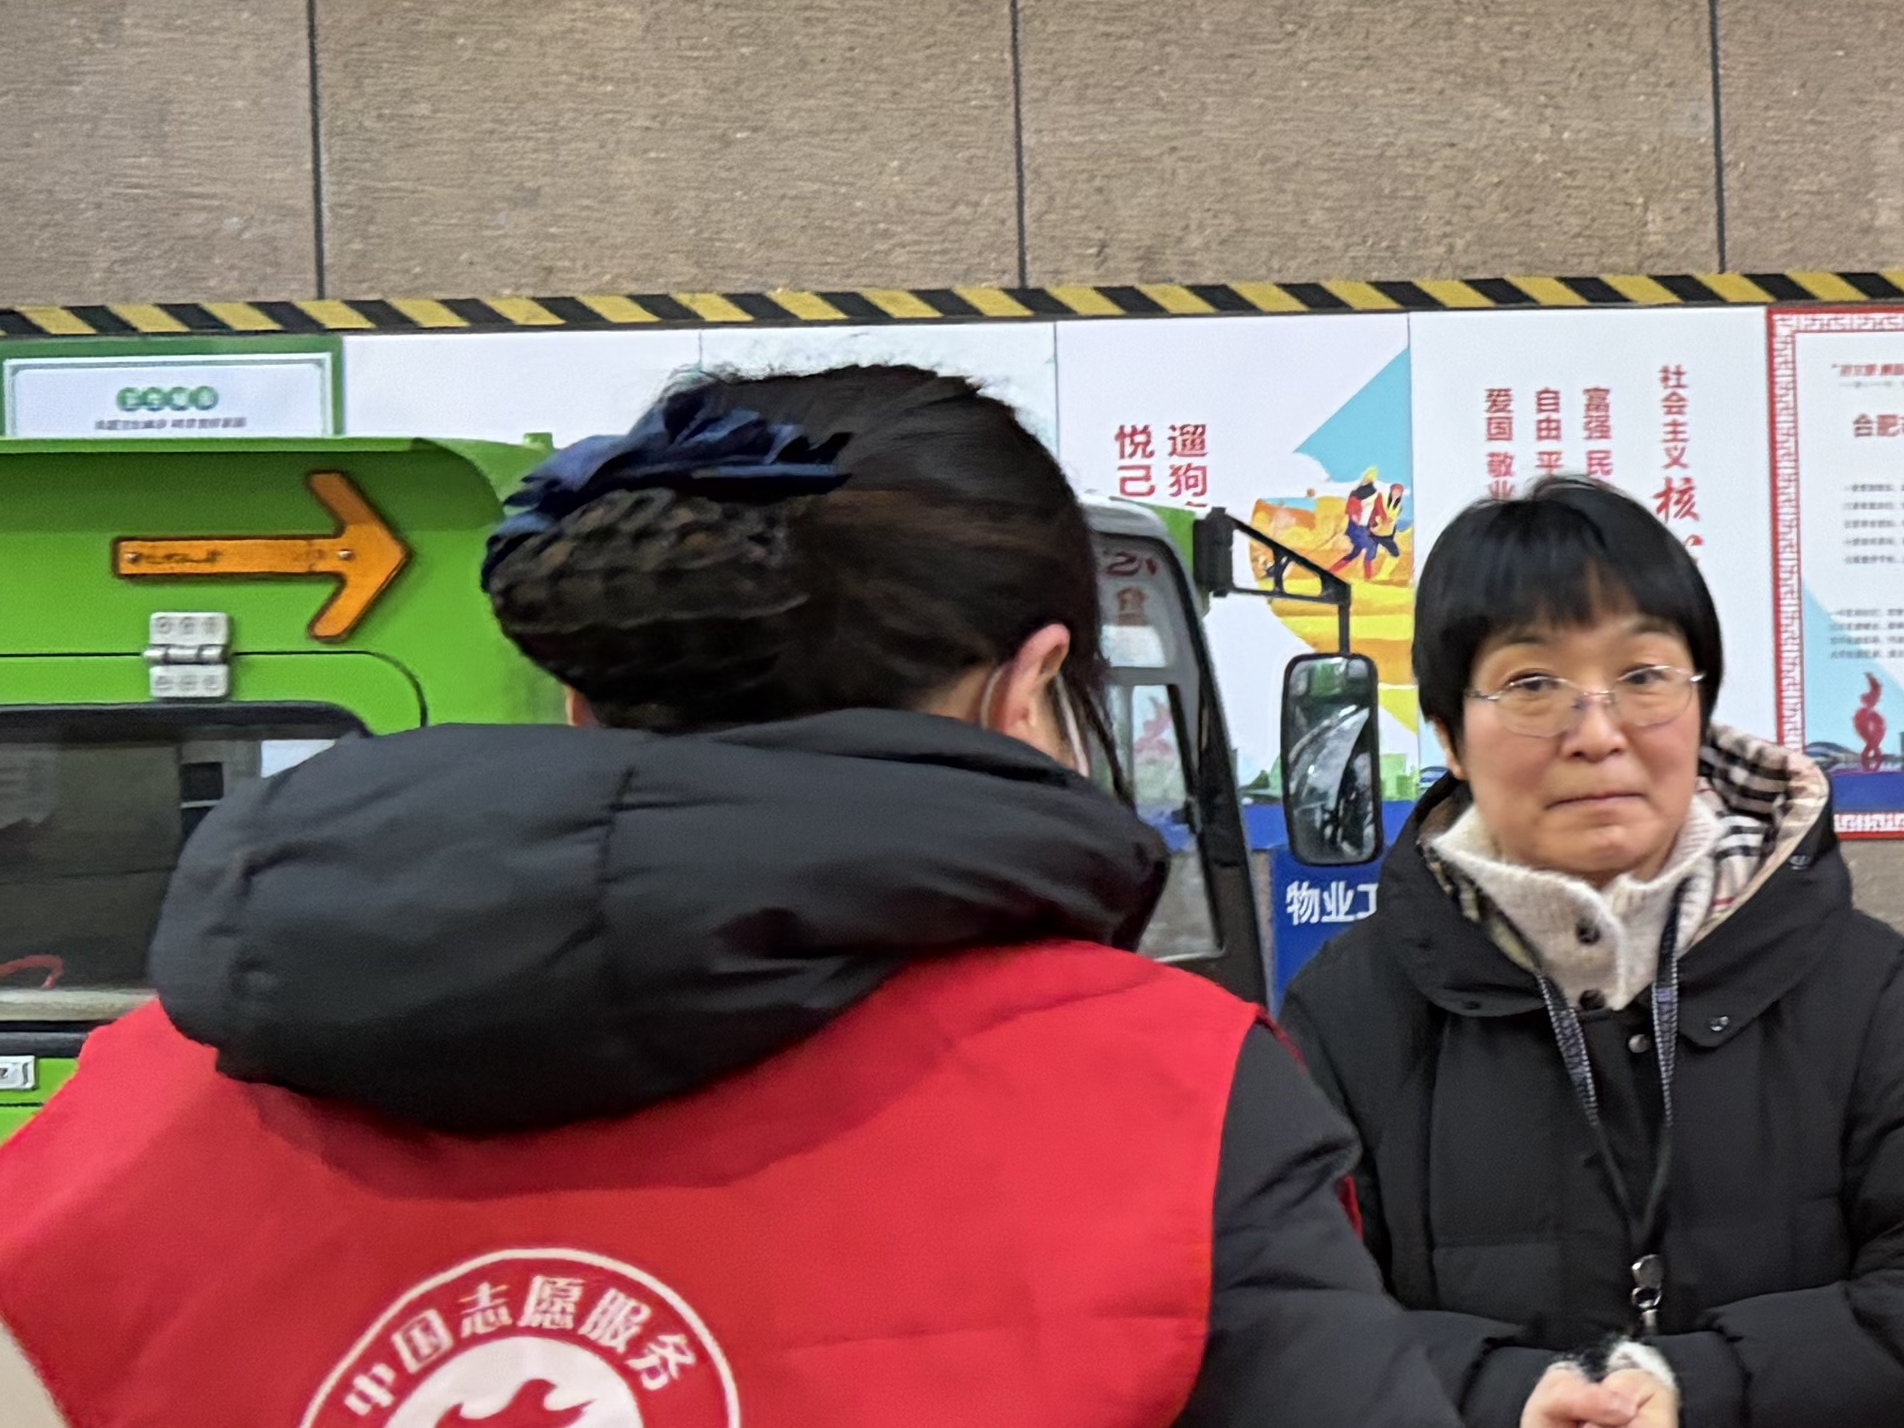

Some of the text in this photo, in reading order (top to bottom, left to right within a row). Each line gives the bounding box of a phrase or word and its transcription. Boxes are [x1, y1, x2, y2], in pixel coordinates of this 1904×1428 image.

[1484, 387, 1514, 441] 爱国
[1167, 423, 1209, 508] 遛狗
[343, 1274, 697, 1417] 中国志愿服务
